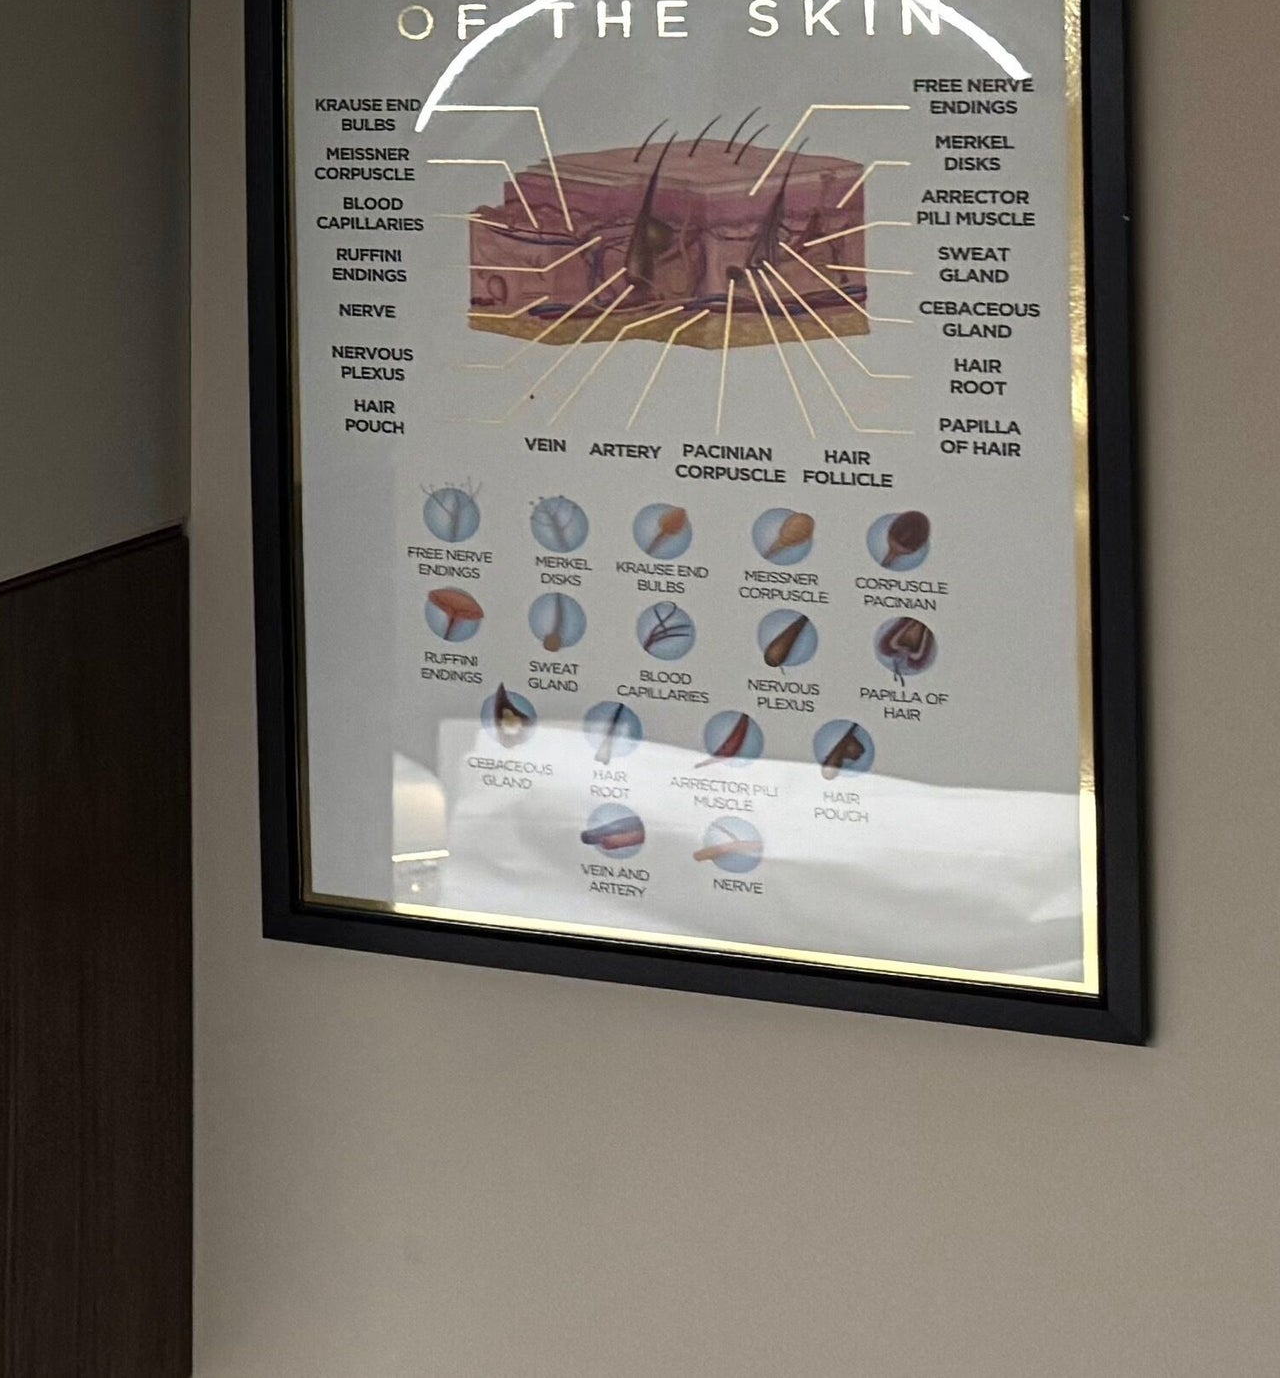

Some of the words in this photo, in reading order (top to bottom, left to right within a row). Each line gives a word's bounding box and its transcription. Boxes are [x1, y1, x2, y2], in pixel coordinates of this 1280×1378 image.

[397, 3, 489, 41] OF
[913, 78, 962, 93] FREE
[967, 78, 1034, 93] NERVE
[315, 98, 382, 112] KRAUSE
[386, 98, 422, 112] END
[930, 100, 1018, 115] ENDINGS
[341, 118, 396, 132] BULBS
[935, 135, 1014, 150] MERKEL
[326, 147, 410, 161] MEISSNER
[944, 157, 1001, 172] DISKS
[314, 167, 415, 181] CORPUSCLE
[343, 197, 404, 211] BLOOD
[921, 190, 1029, 205] ARRECTOR
[316, 217, 424, 232] CAPILLARIES
[917, 211, 951, 226] PILI
[956, 212, 1036, 227] MUSCLE
[336, 248, 402, 263] RUFFINI
[938, 247, 1010, 262] SWEAT
[332, 268, 407, 282] ENDINGS
[939, 268, 1009, 284] GLAND
[339, 304, 396, 318] NERVE
[919, 301, 1041, 318] CEBACEOUS
[942, 324, 1012, 339] GLAND
[331, 346, 414, 361] NERVOUS
[341, 366, 405, 382] PLEXUS
[954, 358, 1002, 374] HAIR
[950, 380, 1007, 396] ROOT
[354, 399, 395, 414] HAIR
[345, 419, 405, 434] POUCH
[939, 418, 1021, 435] PAPILLA
[524, 437, 567, 454] VEIN
[589, 442, 662, 461] ARTERY
[682, 443, 772, 463] PACINIAN
[940, 440, 969, 455] OF
[972, 441, 1021, 457] HAIR
[823, 448, 871, 466] HAIR
[675, 464, 786, 484] CORPUSCLE
[802, 469, 894, 489] FOLLICLE
[407, 546, 444, 562] FREE
[446, 548, 493, 565] NERVE
[535, 555, 592, 572] MERKEL
[417, 564, 481, 581] ENDINGS
[616, 560, 674, 576] KRAUSE
[677, 563, 709, 579] END
[744, 569, 818, 587] MEISSNER
[539, 571, 582, 587] DISKS
[637, 578, 685, 595] BULBS
[855, 576, 949, 596] CORPUSCLE
[739, 586, 829, 605] CORPUSCLE
[862, 594, 937, 612] PACINIAN
[424, 650, 478, 667] RUFFINI
[420, 667, 482, 685] ENDINGS
[529, 660, 579, 677] SWEAT
[528, 676, 578, 694] GLAND
[639, 669, 692, 686] BLOOD
[616, 684, 709, 704] CAPILLARIES
[747, 678, 820, 696] NERVOUS
[756, 696, 815, 713] PLEXUS
[859, 687, 922, 705] PAPILLA
[925, 691, 950, 706] OF
[883, 705, 922, 722] HAIR
[467, 756, 554, 776] CEBACEOUS
[481, 774, 532, 791] GLAND
[591, 769, 628, 785] HAIR
[590, 784, 631, 800] ROOT
[670, 776, 749, 796] ARRECTOR
[751, 781, 780, 798] PILI
[693, 796, 754, 813] MUSCLE
[822, 789, 860, 806] HAIR
[814, 807, 869, 823] POUCH
[581, 863, 615, 879] VEIN
[617, 865, 650, 882] AND
[589, 881, 647, 897] ARTERY
[713, 878, 764, 895] NERVE
